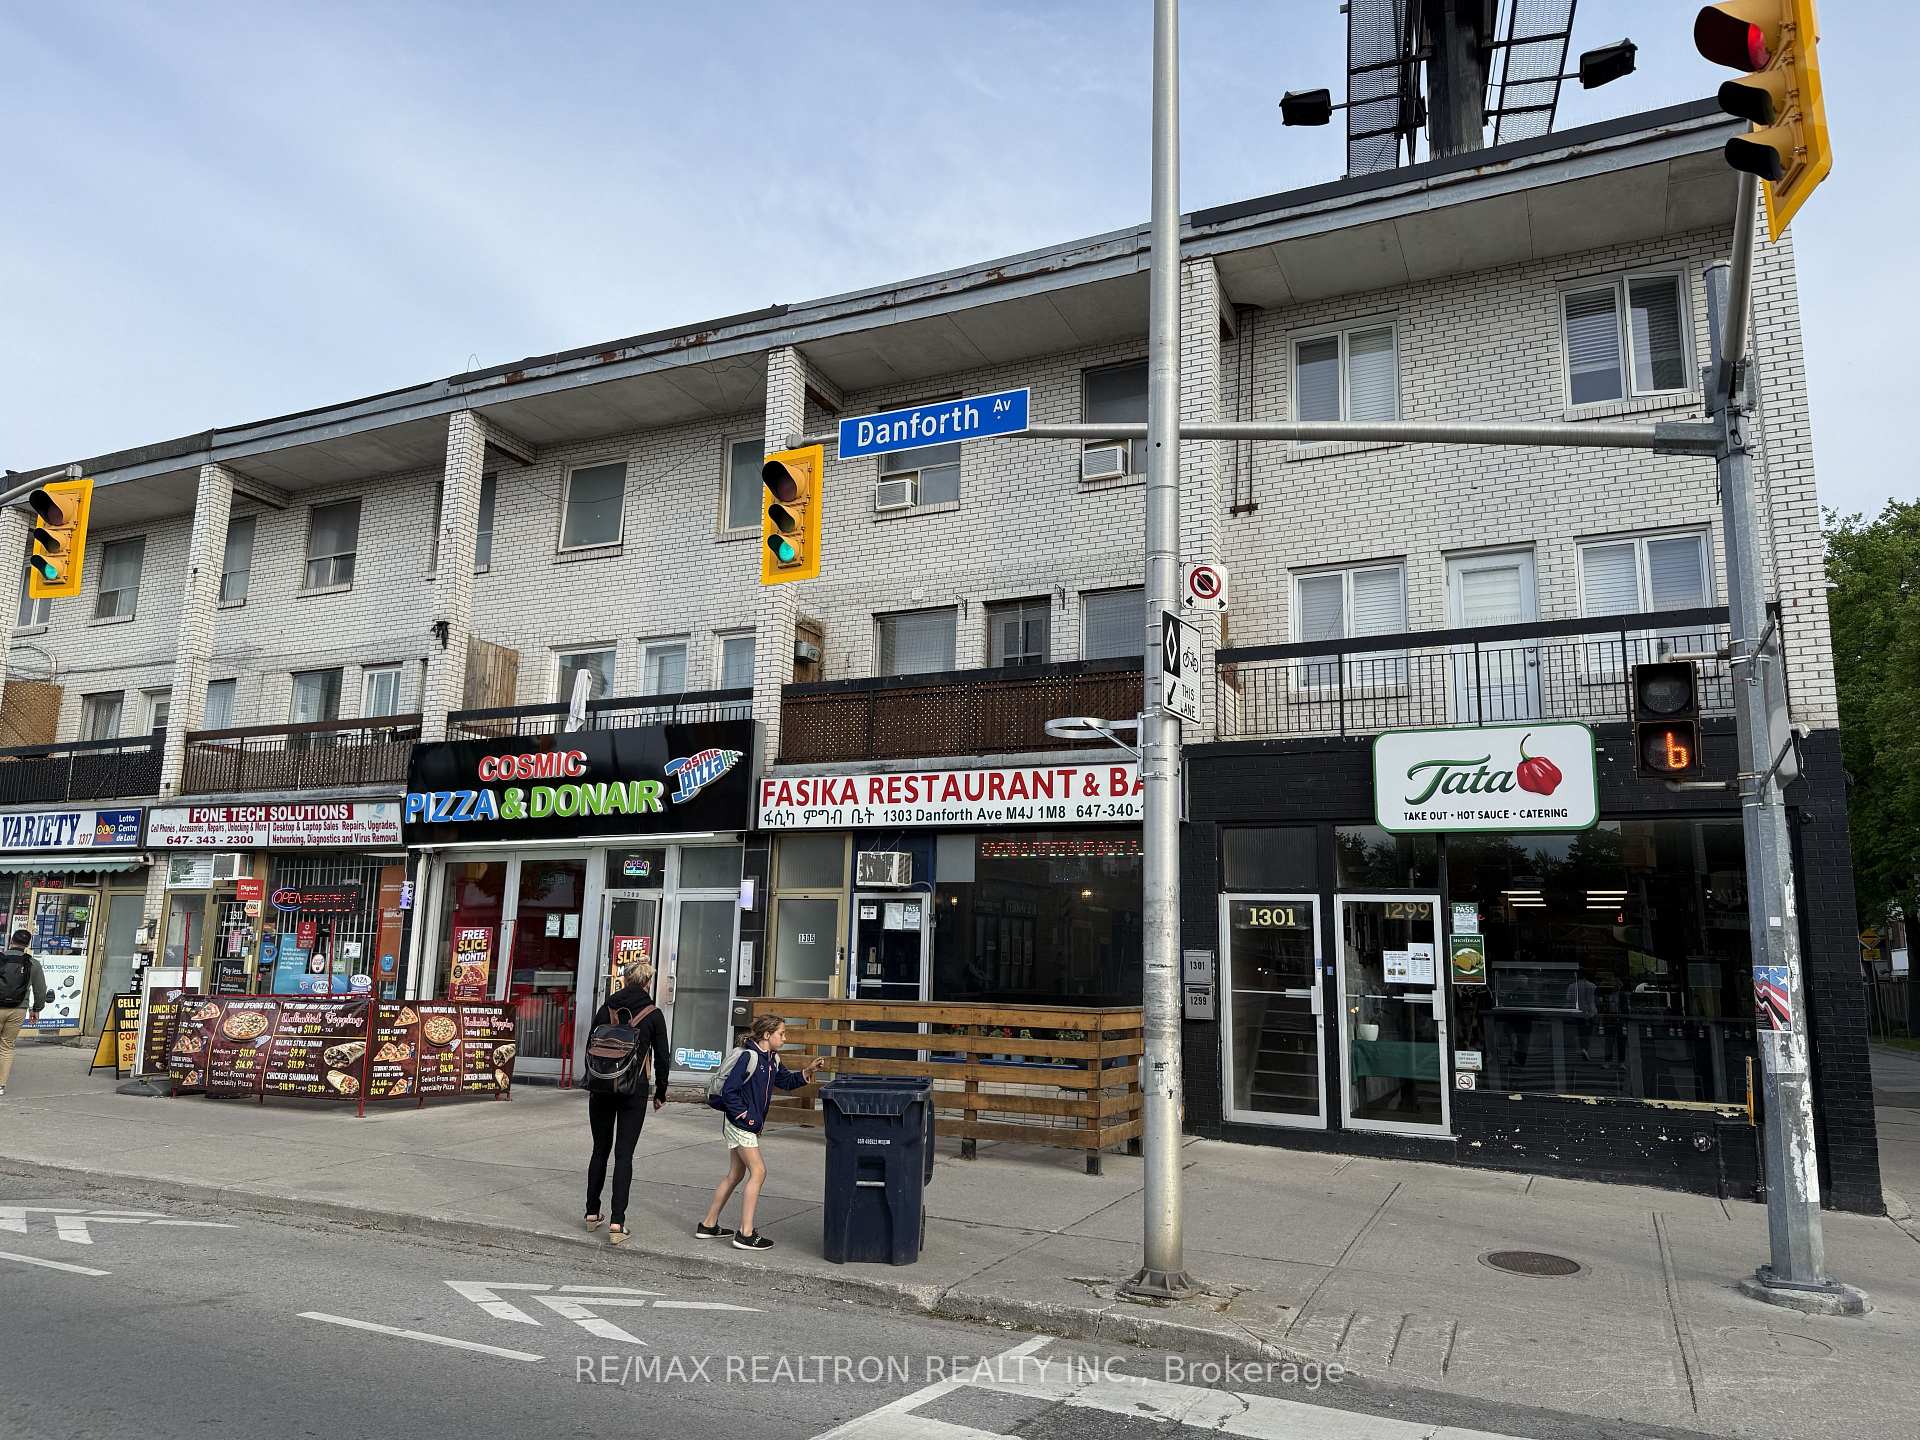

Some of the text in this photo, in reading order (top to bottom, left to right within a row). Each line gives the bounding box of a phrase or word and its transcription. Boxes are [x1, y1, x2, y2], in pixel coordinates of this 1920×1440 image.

[857, 399, 1011, 447] Danforth Av
[1181, 684, 1195, 702] THIS
[479, 750, 587, 781] COSMIC
[679, 749, 721, 774] COSMIC
[1404, 754, 1517, 805] Tata
[762, 767, 1144, 807] FASIKA RESTAURANT & BA
[405, 780, 664, 824] PIZZA & DONAIR
[193, 804, 349, 822] FONE TECH SOLUTIONS
[884, 803, 1144, 822] 1303 Danforth Ave M4J 1M8 647-340-
[1404, 808, 1568, 821] TAKE OUT HOT SAUCE CATERING
[119, 815, 135, 823] Lotto
[1, 814, 81, 847] VARIETY
[118, 824, 137, 832] Centre
[150, 824, 159, 832] Cell
[254, 823, 267, 831] More
[272, 822, 295, 832] Desktop
[302, 822, 322, 832] Laptop
[323, 821, 339, 831] Sales
[367, 820, 399, 832] Upgrades,
[272, 832, 398, 846] Networking, Diagnostics and Virus Removal
[273, 891, 302, 904] OPEN
[1384, 903, 1430, 919] 1299
[1455, 906, 1475, 914] PASS
[1249, 907, 1296, 926] 1301
[462, 929, 485, 940] FREE
[799, 933, 816, 944] 1305
[457, 939, 487, 952] SLICE
[621, 939, 644, 951] FREE
[457, 951, 487, 962] MONTH
[1189, 961, 1205, 970] 1301
[352, 975, 369, 984] RAZA
[118, 998, 135, 1008] CELL
[264, 1002, 277, 1010] DEAL
[1190, 996, 1207, 1006] 1299
[125, 1009, 139, 1019] REP
[149, 1004, 170, 1014] LUNCH
[325, 1010, 364, 1027] Topping
[120, 1020, 138, 1030] UNLO
[279, 1025, 297, 1033] Starting
[303, 1025, 322, 1034] $11.99
[289, 1048, 307, 1057] $9.99
[287, 1060, 305, 1069] $11.99
[266, 1072, 319, 1081] CHICKEN SHAWARMA
[421, 1075, 436, 1083] Select
[307, 1083, 326, 1093] $12.99
